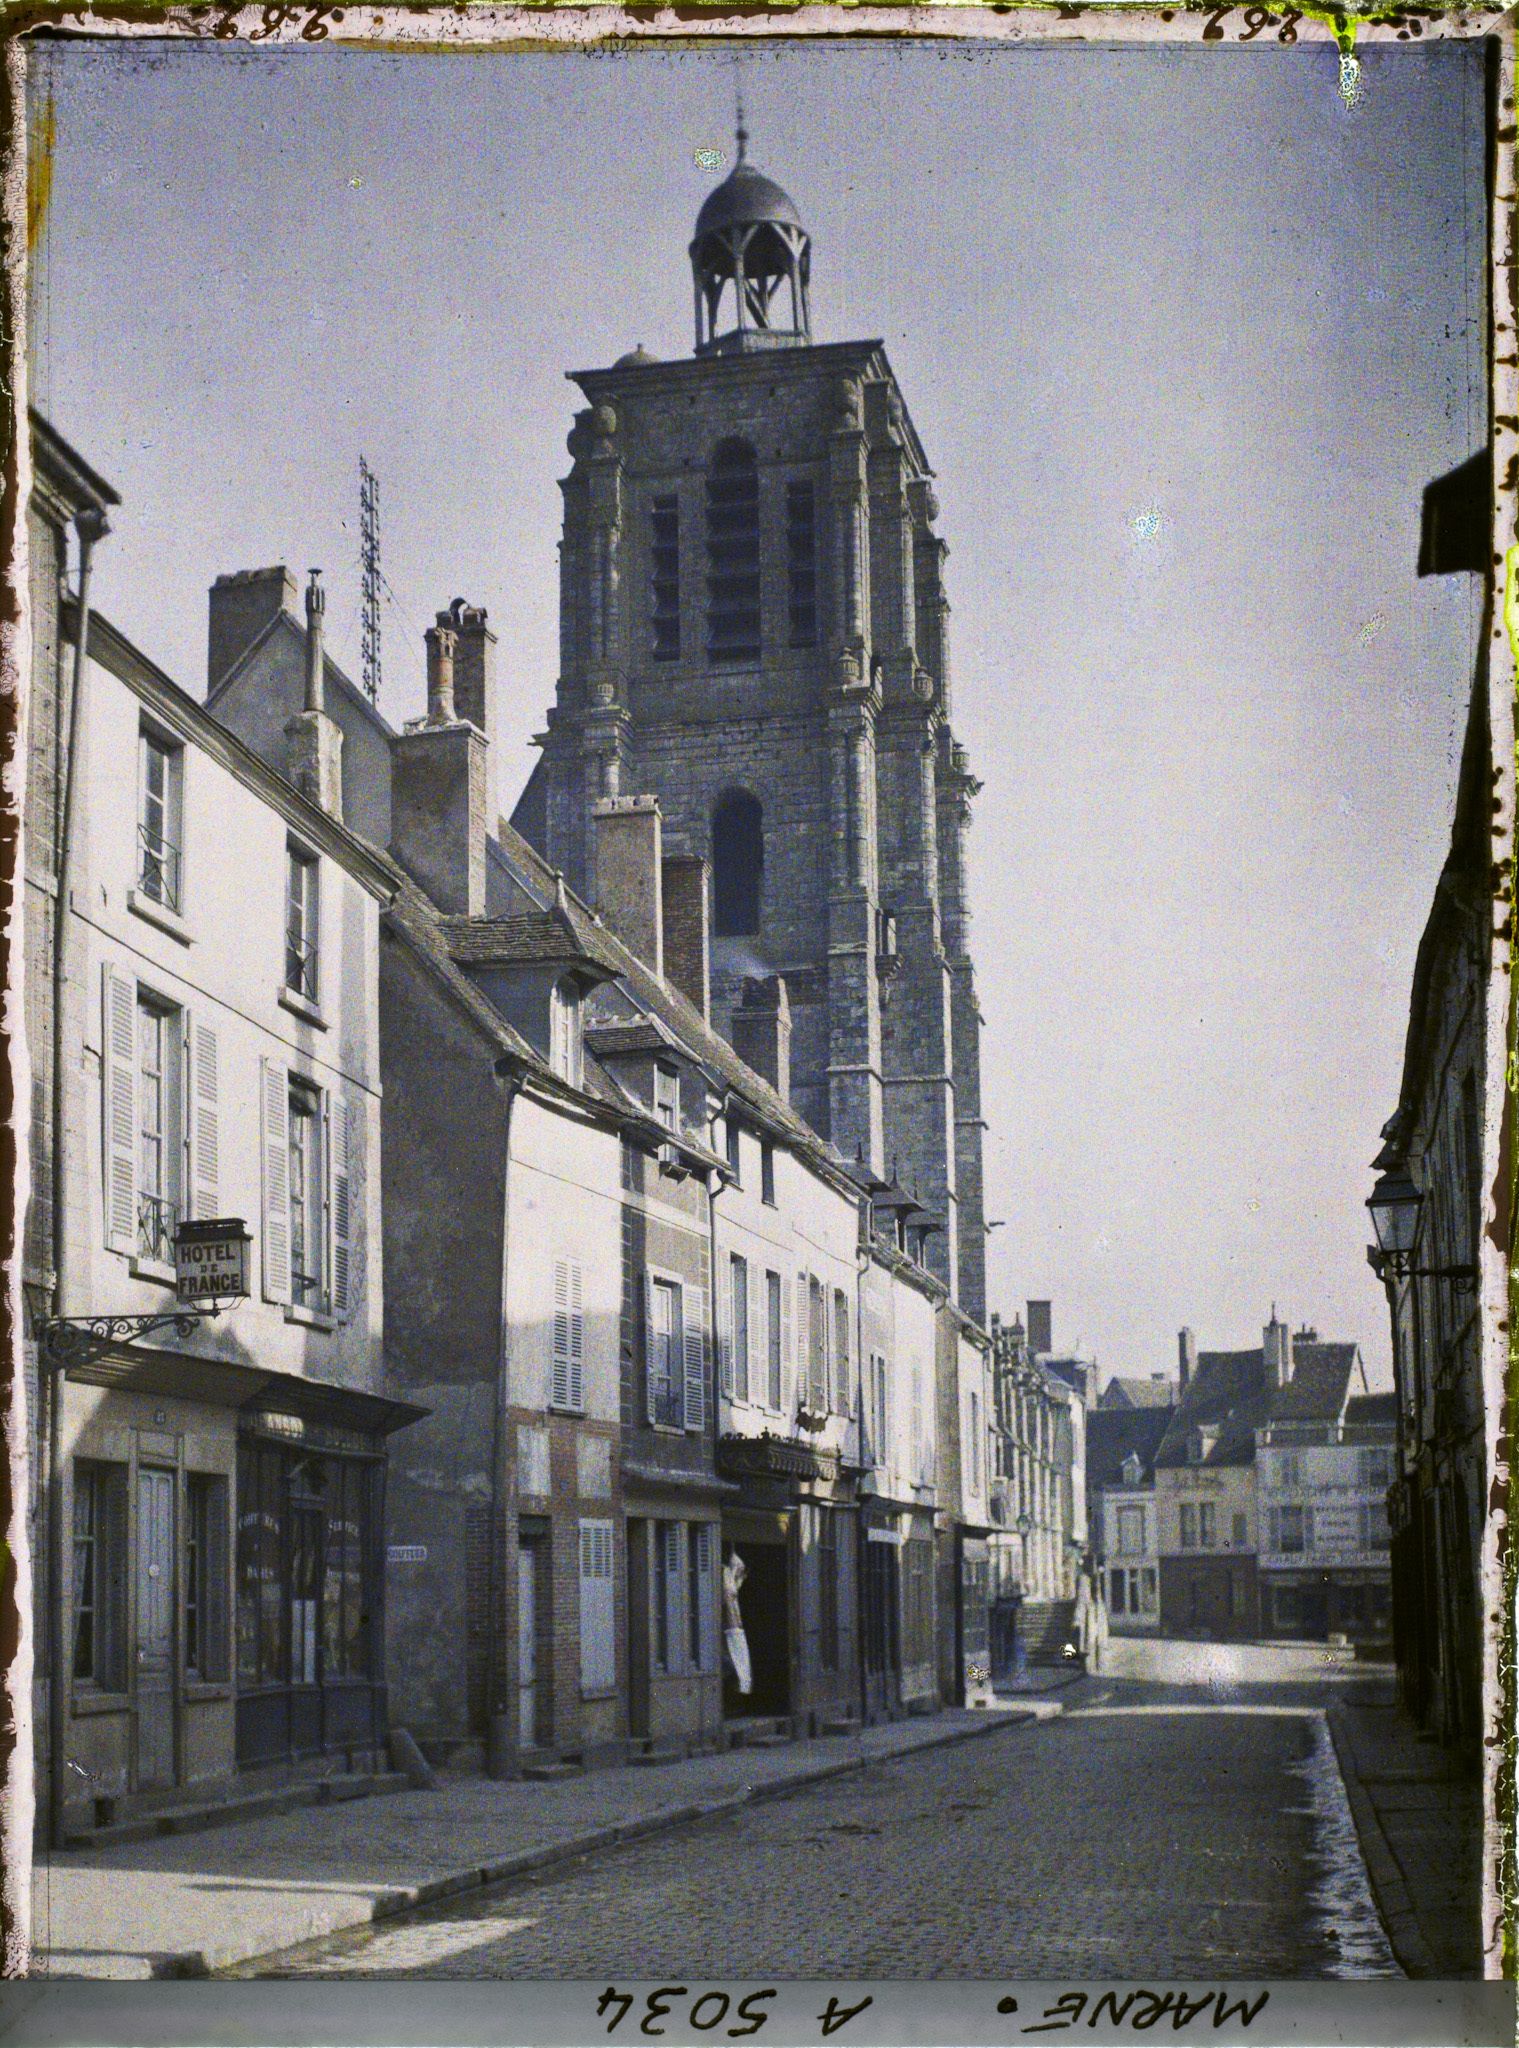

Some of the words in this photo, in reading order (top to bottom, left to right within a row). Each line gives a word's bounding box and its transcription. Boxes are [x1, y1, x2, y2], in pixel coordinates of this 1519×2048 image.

[181, 1243, 236, 1263] HOTEL
[201, 1263, 219, 1272] DE
[180, 1273, 240, 1295] FRANCE
[597, 1987, 777, 2037] 5034
[817, 1996, 874, 2036] A
